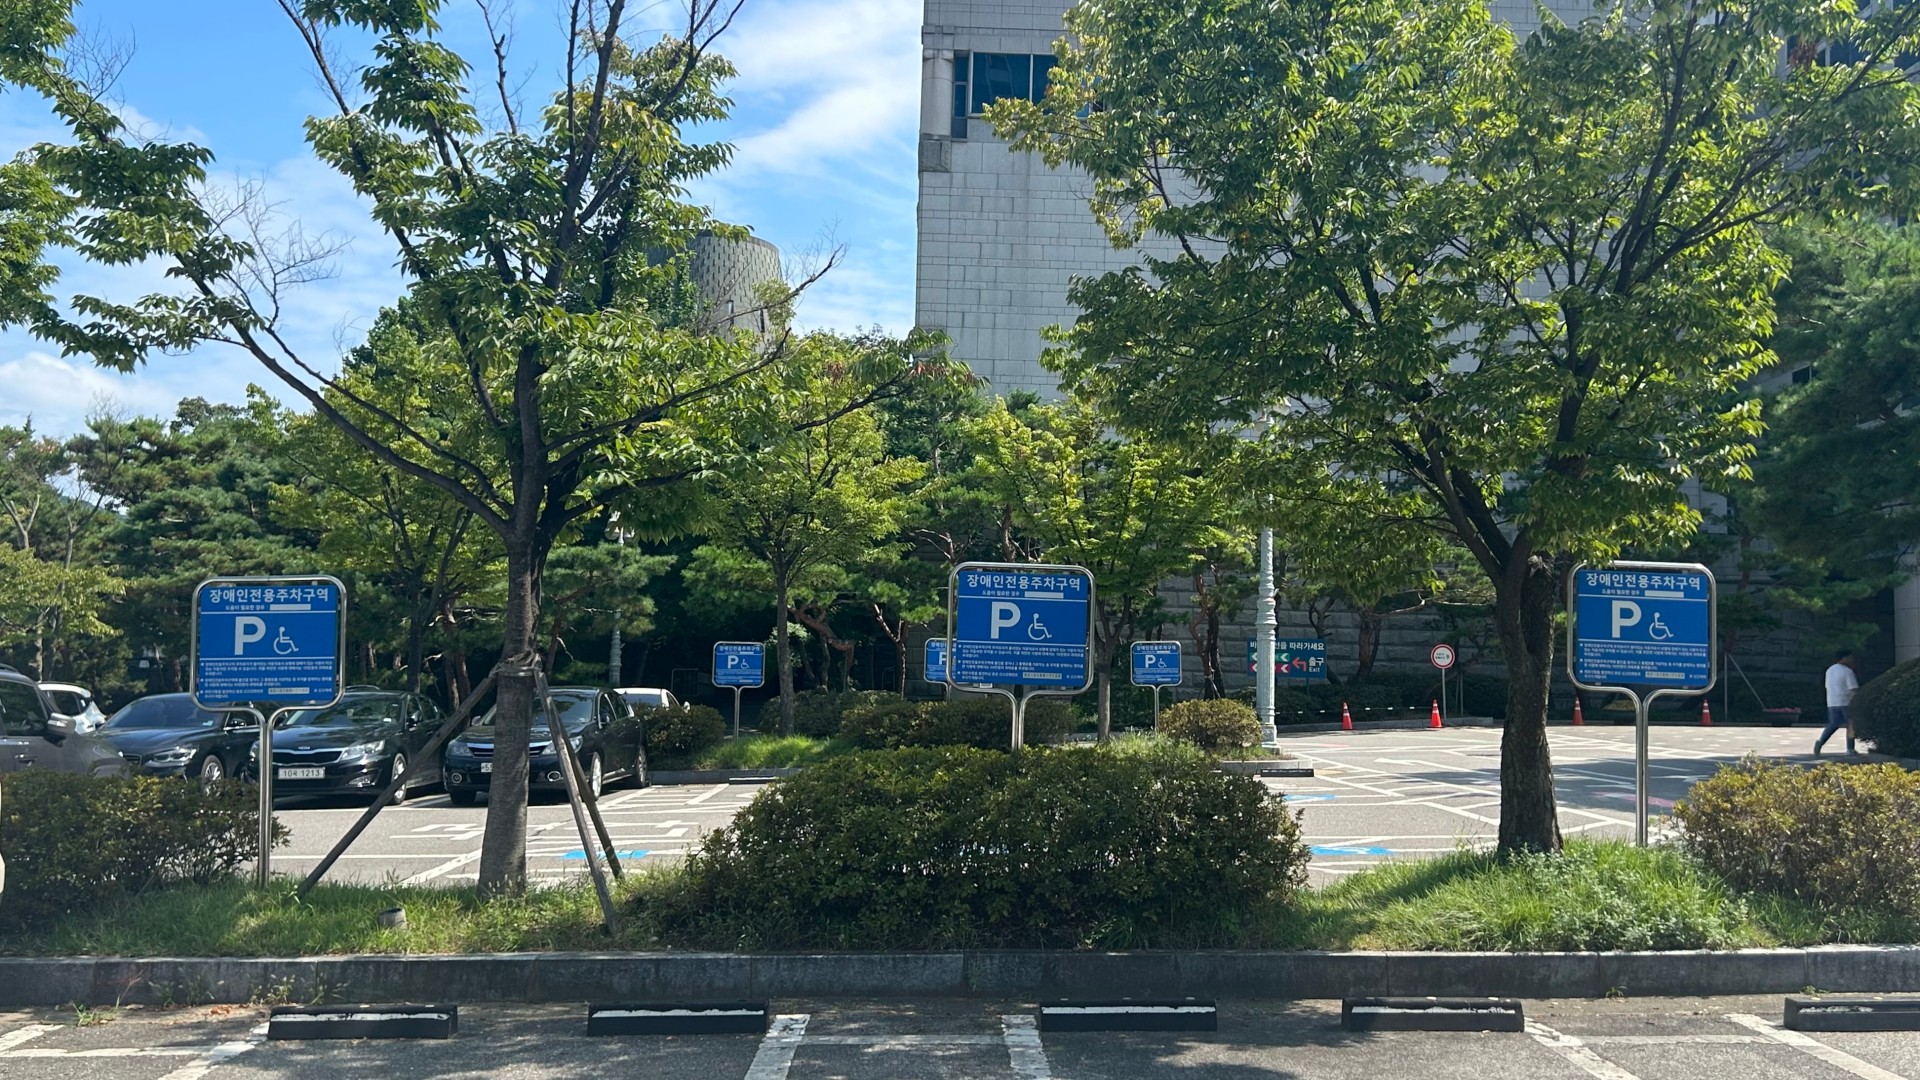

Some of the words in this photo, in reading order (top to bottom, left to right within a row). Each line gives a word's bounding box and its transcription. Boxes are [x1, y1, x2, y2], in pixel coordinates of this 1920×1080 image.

[966, 574, 1081, 592] 장애인전용주차구역
[1586, 572, 1700, 591] 장애인전용주차구역
[209, 587, 329, 604] 장애인전용주차구역
[990, 601, 1021, 639] P
[1611, 600, 1642, 638] P
[234, 616, 267, 655] P
[1289, 642, 1325, 651] 따라가세요
[727, 655, 739, 669] P
[1145, 654, 1156, 668] P
[1308, 656, 1325, 667] 출구
[301, 769, 320, 777] 1213
